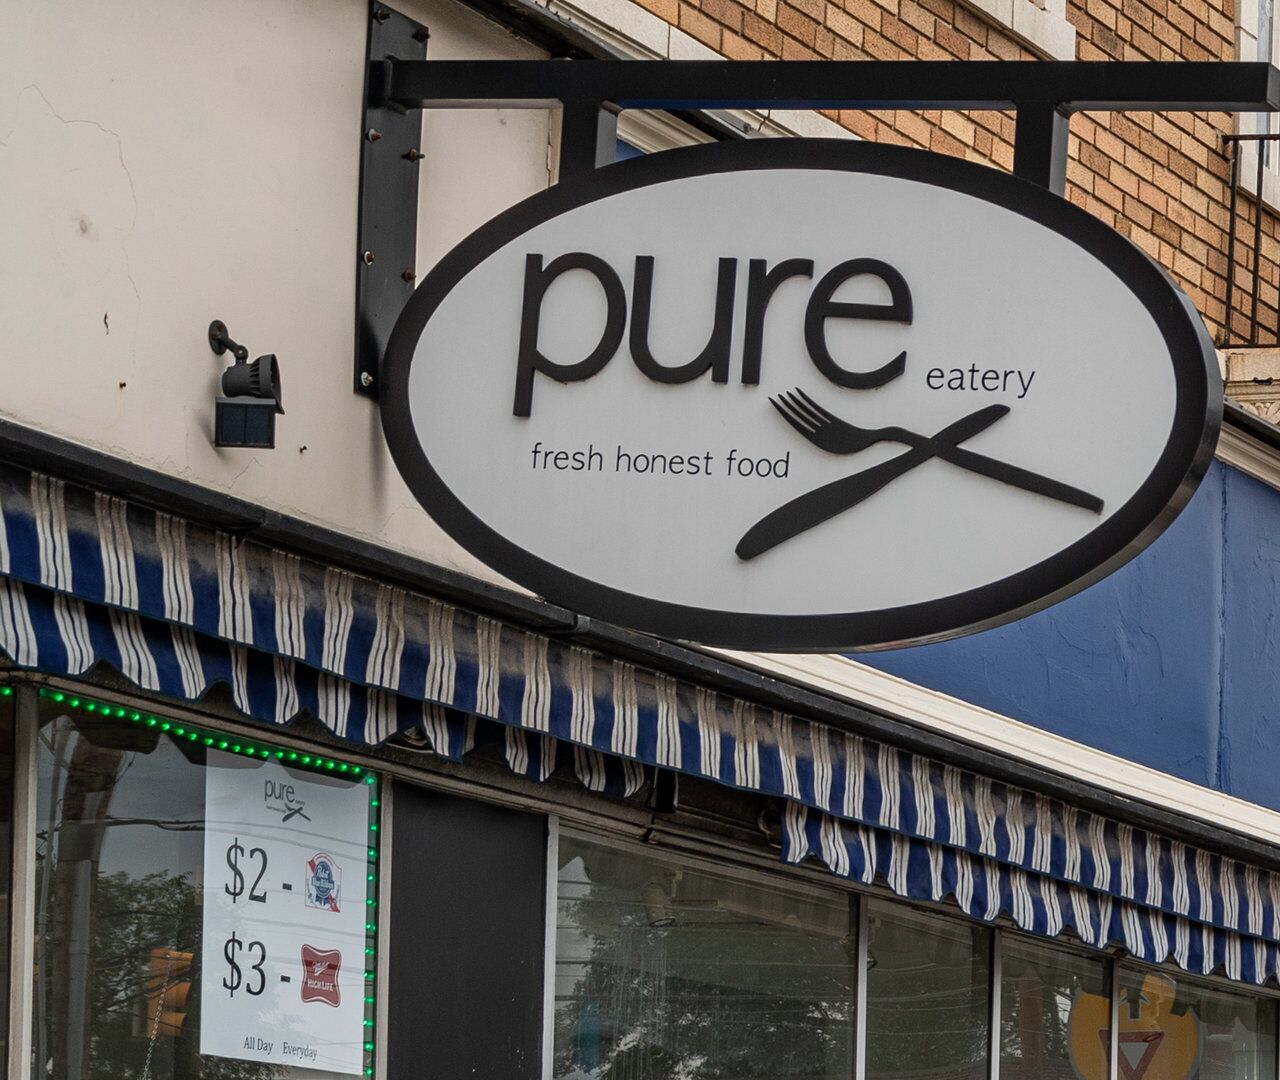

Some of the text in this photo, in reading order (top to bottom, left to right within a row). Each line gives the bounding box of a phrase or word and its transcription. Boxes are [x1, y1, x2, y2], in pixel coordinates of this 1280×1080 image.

[513, 252, 913, 418] pure
[926, 364, 1036, 399] eatery
[531, 441, 790, 479] fresh honest food
[265, 779, 295, 803] pure
[225, 837, 268, 904] $2
[223, 932, 266, 998] $3
[243, 1037, 318, 1062] All Day Everyday
